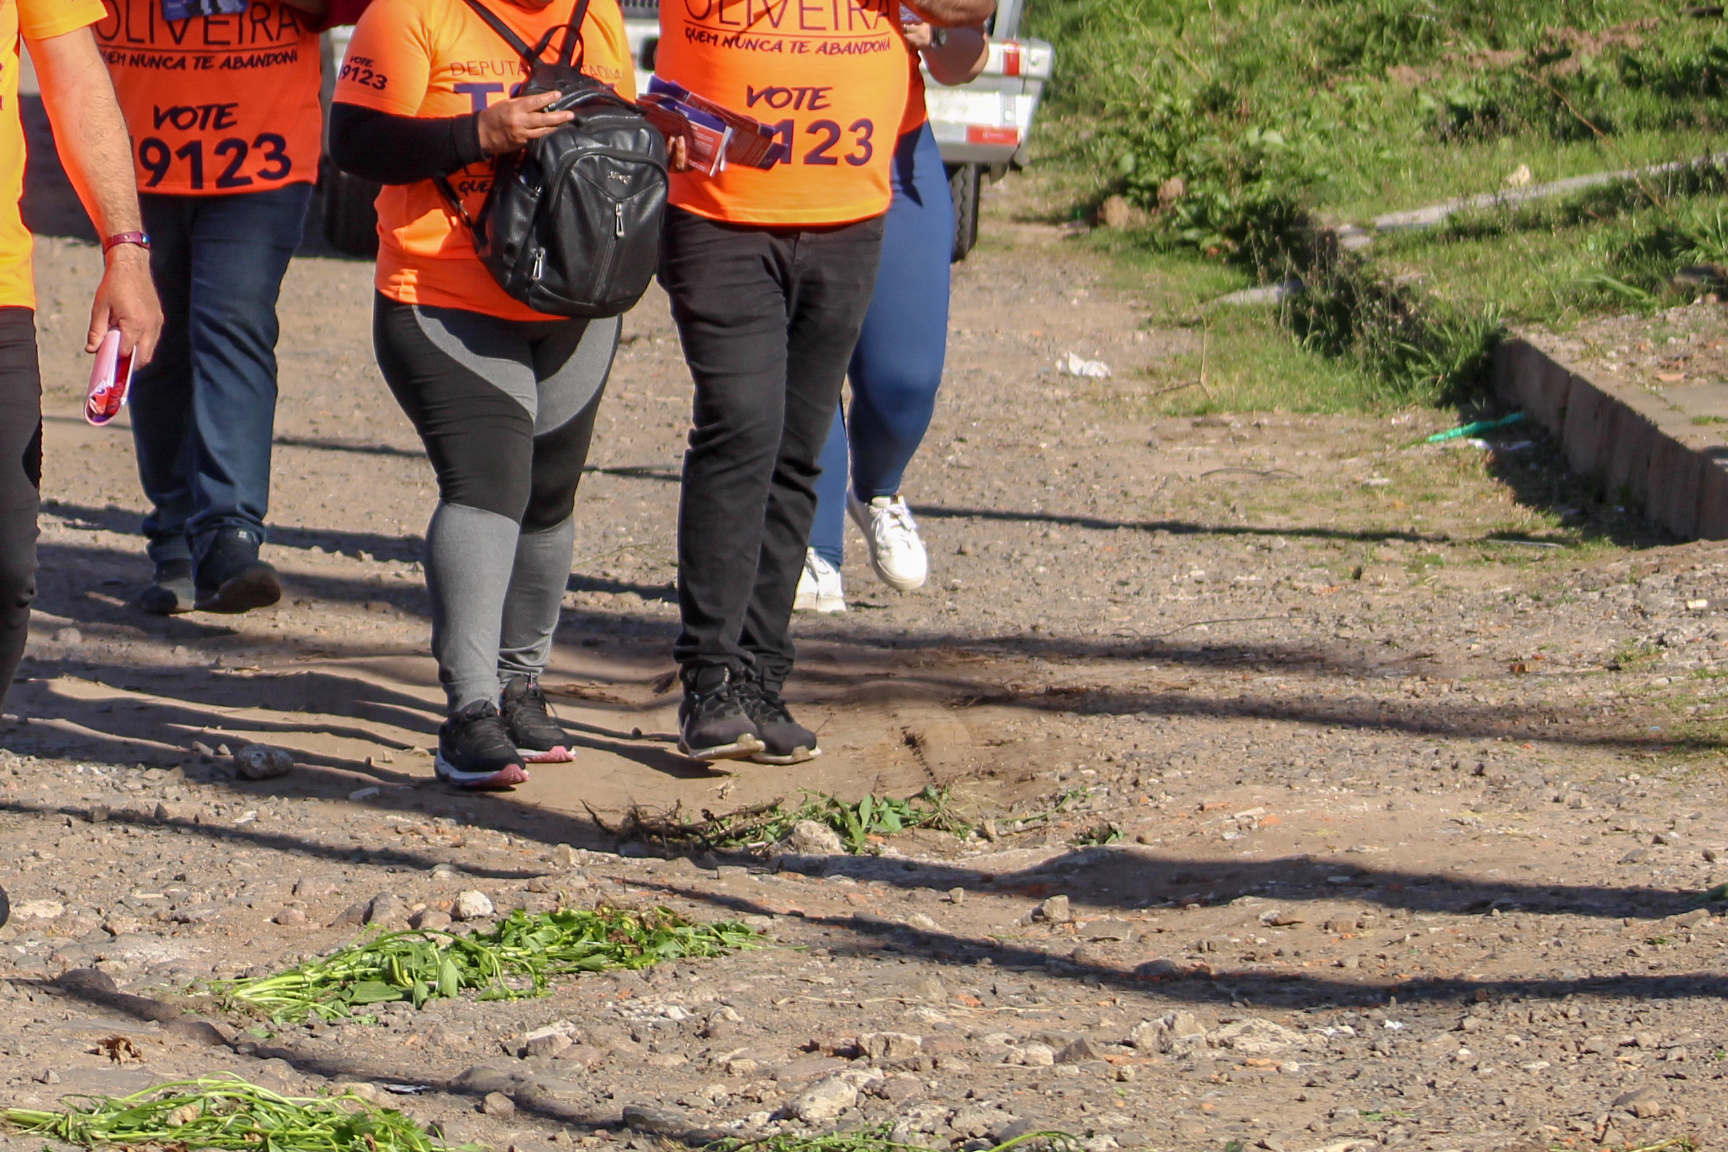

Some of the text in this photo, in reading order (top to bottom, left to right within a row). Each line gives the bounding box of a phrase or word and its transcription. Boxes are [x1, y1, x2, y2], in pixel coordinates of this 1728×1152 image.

[685, 27, 891, 56] QUEM NUNCA TE ABANDONA
[130, 52, 186, 70] NUNCA
[192, 55, 215, 69] TE
[746, 84, 833, 111] VOTE
[153, 103, 239, 131] VOTE
[134, 132, 292, 190] 9123
